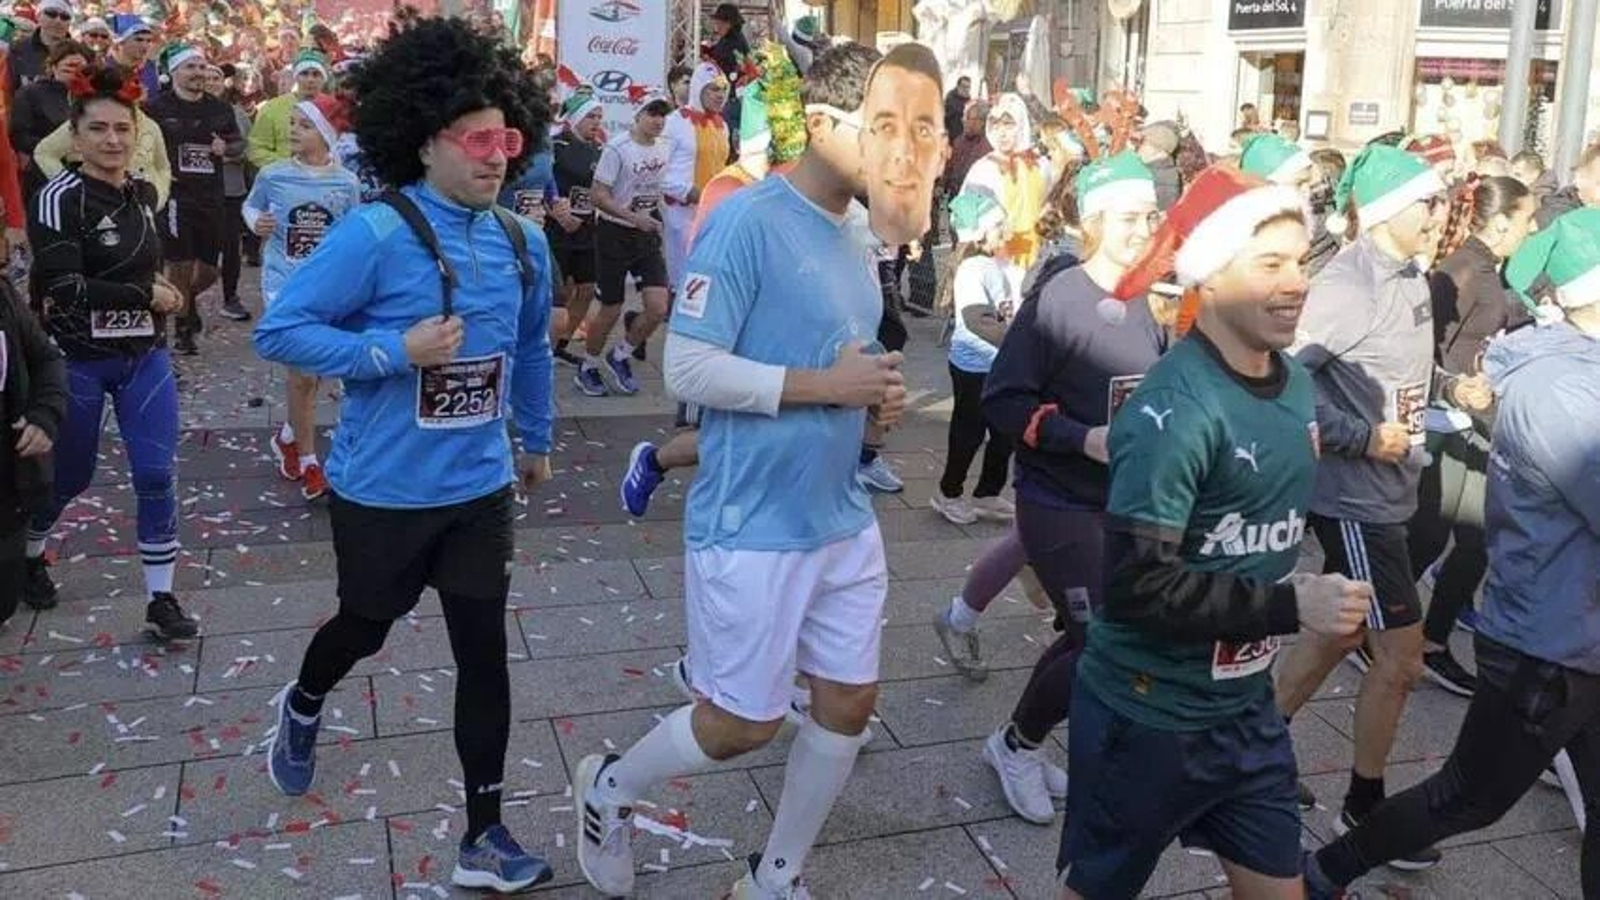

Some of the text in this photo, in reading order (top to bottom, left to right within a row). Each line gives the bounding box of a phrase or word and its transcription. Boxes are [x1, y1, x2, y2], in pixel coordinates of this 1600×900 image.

[1235, 2, 1260, 14] Puerta
[1262, 0, 1275, 13] del
[105, 310, 152, 329] 2373
[434, 388, 495, 416] 2252
